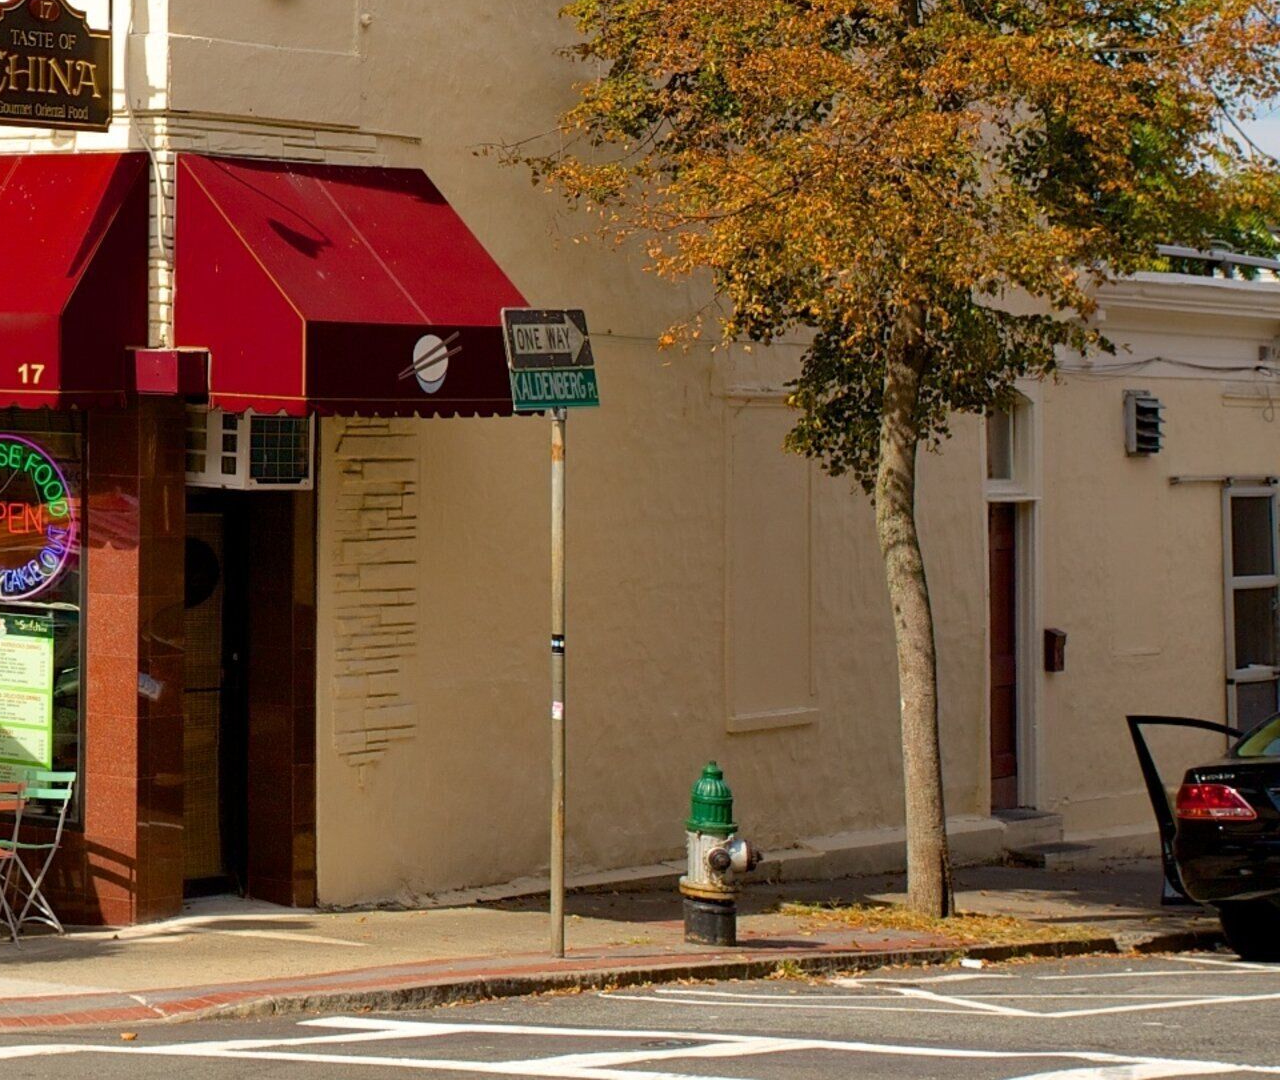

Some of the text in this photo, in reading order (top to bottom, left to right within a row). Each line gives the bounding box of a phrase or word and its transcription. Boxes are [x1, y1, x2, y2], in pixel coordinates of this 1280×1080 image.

[39, 1, 53, 19] 17
[10, 29, 77, 50] TASTE OF
[35, 103, 66, 118] Oriental
[68, 105, 89, 120] Food
[516, 327, 570, 350] ONE WAY
[18, 363, 45, 384] 17
[511, 372, 598, 400] KALDENBERG PL
[24, 453, 68, 517] FOOD
[1, 559, 42, 592] TAKE
[40, 524, 67, 569] OUT
